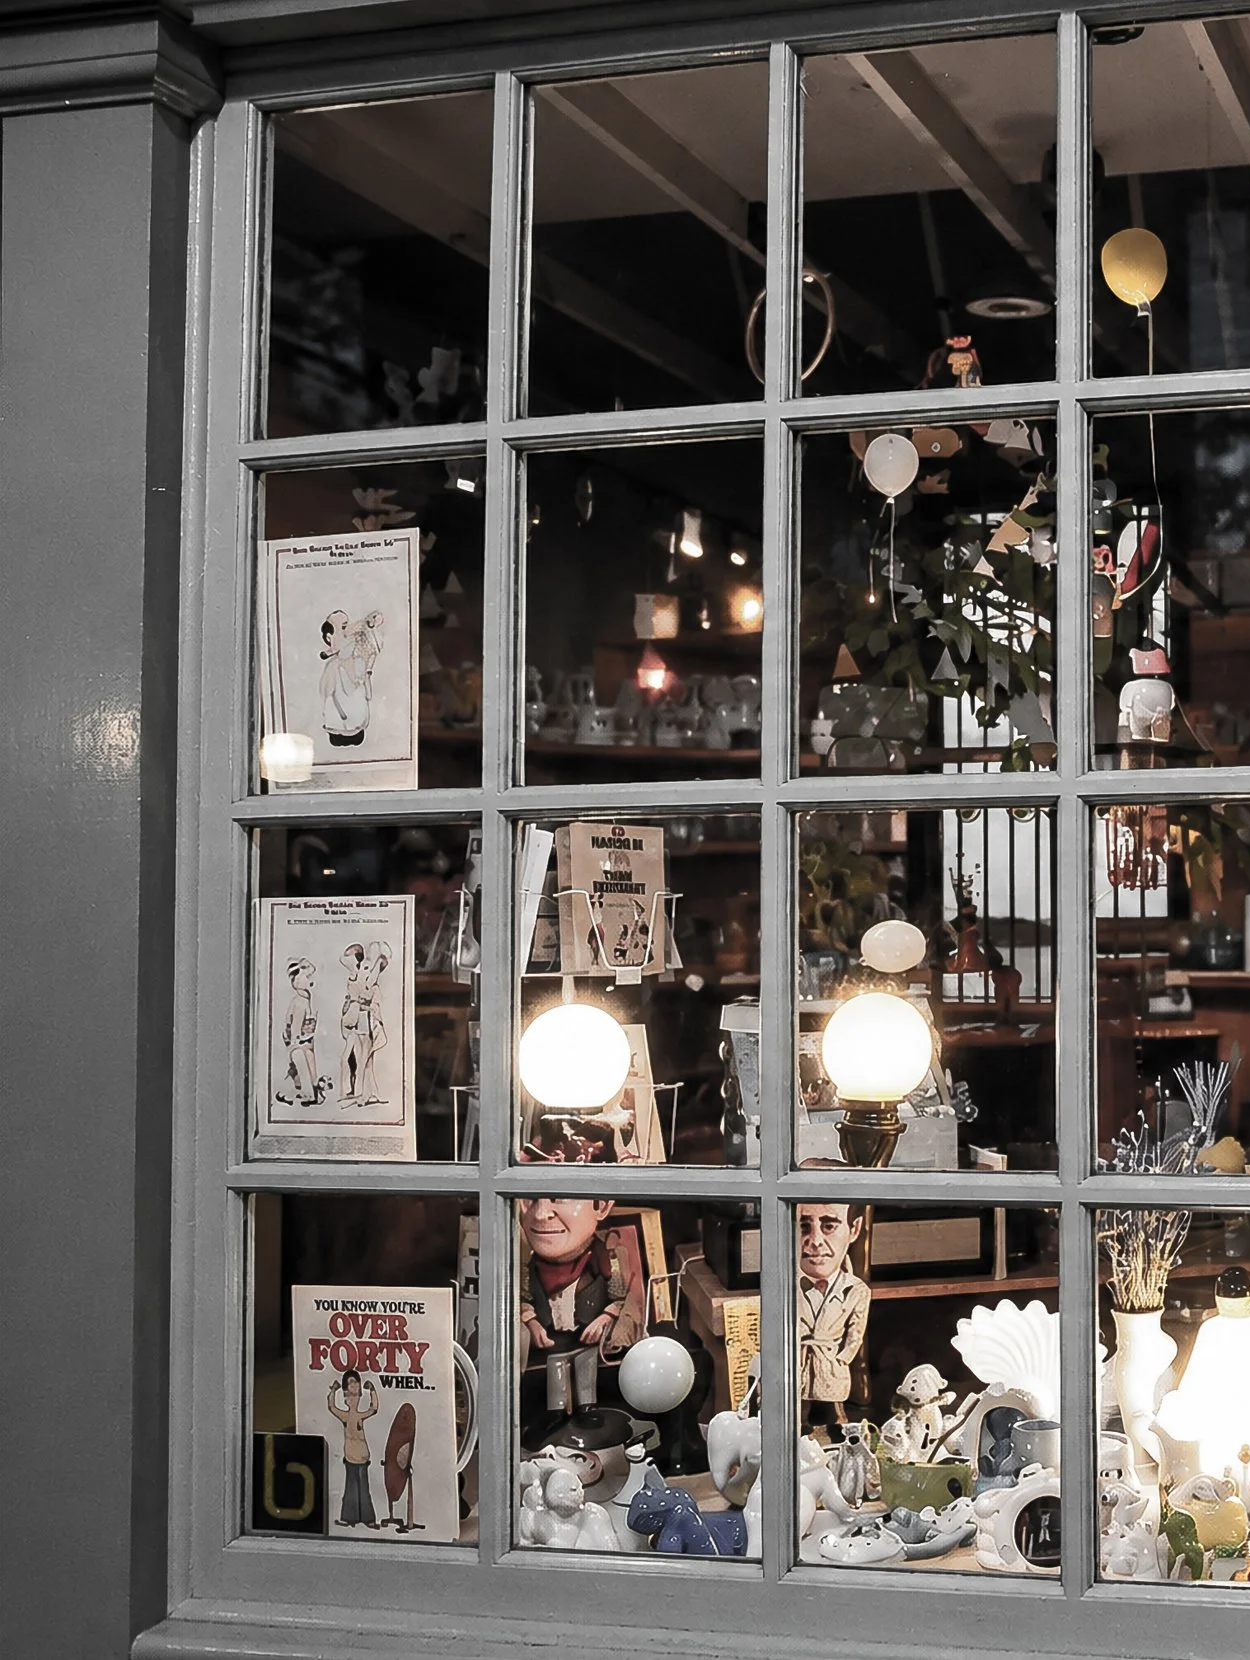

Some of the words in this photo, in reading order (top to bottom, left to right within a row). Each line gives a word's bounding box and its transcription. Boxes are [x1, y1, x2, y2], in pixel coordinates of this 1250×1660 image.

[314, 1299, 339, 1311] YOU
[341, 1300, 379, 1312] KNOW
[381, 1301, 425, 1314] YOU'RE
[328, 1312, 409, 1341] OVER
[308, 1338, 430, 1375] FORTY
